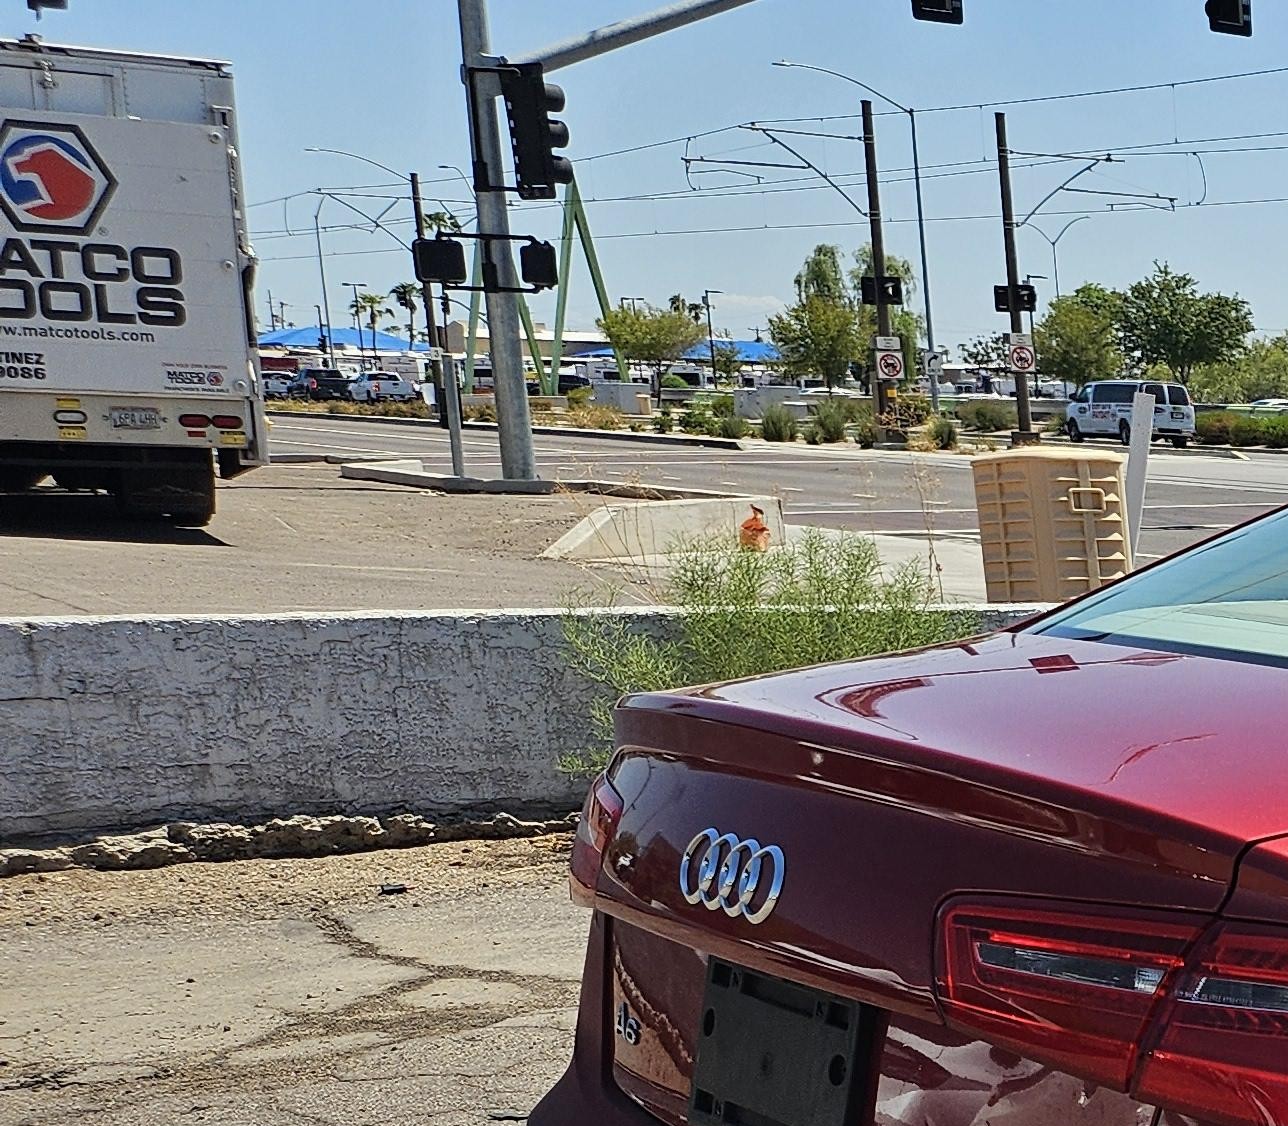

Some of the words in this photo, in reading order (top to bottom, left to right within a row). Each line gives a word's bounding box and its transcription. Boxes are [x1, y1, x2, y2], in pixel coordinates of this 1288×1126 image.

[0, 325, 155, 342] w.matcotools.com
[167, 370, 205, 378] MATCO
[167, 377, 206, 385] TOOLS
